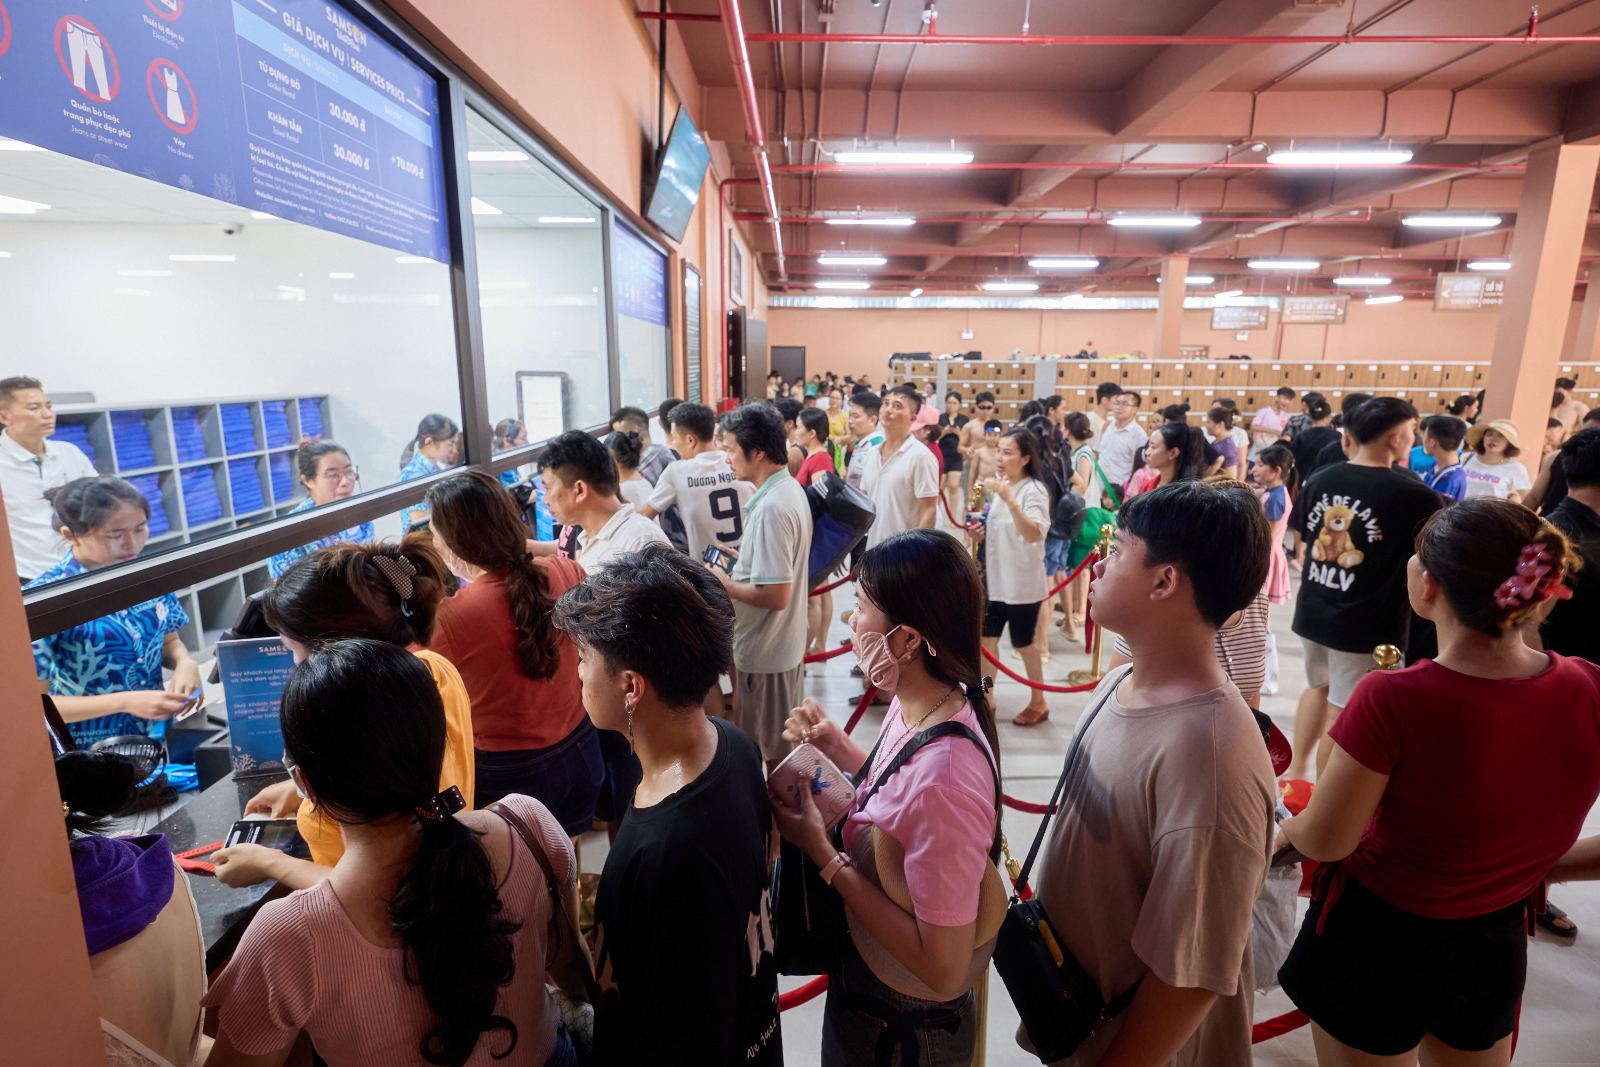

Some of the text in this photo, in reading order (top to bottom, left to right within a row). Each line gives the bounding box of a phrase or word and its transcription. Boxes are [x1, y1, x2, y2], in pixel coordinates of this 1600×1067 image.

[283, 12, 303, 35] GIÁ
[306, 26, 329, 52] DỊCH
[331, 44, 344, 65] VỤ
[351, 58, 385, 89] SERVICES
[386, 82, 404, 102] PRICE
[329, 102, 358, 128] 30.000
[334, 144, 362, 167] 30.000
[718, 472, 737, 484] Ngo
[708, 488, 743, 543] 9
[1333, 495, 1351, 509] DE
[1365, 518, 1383, 543] VIE
